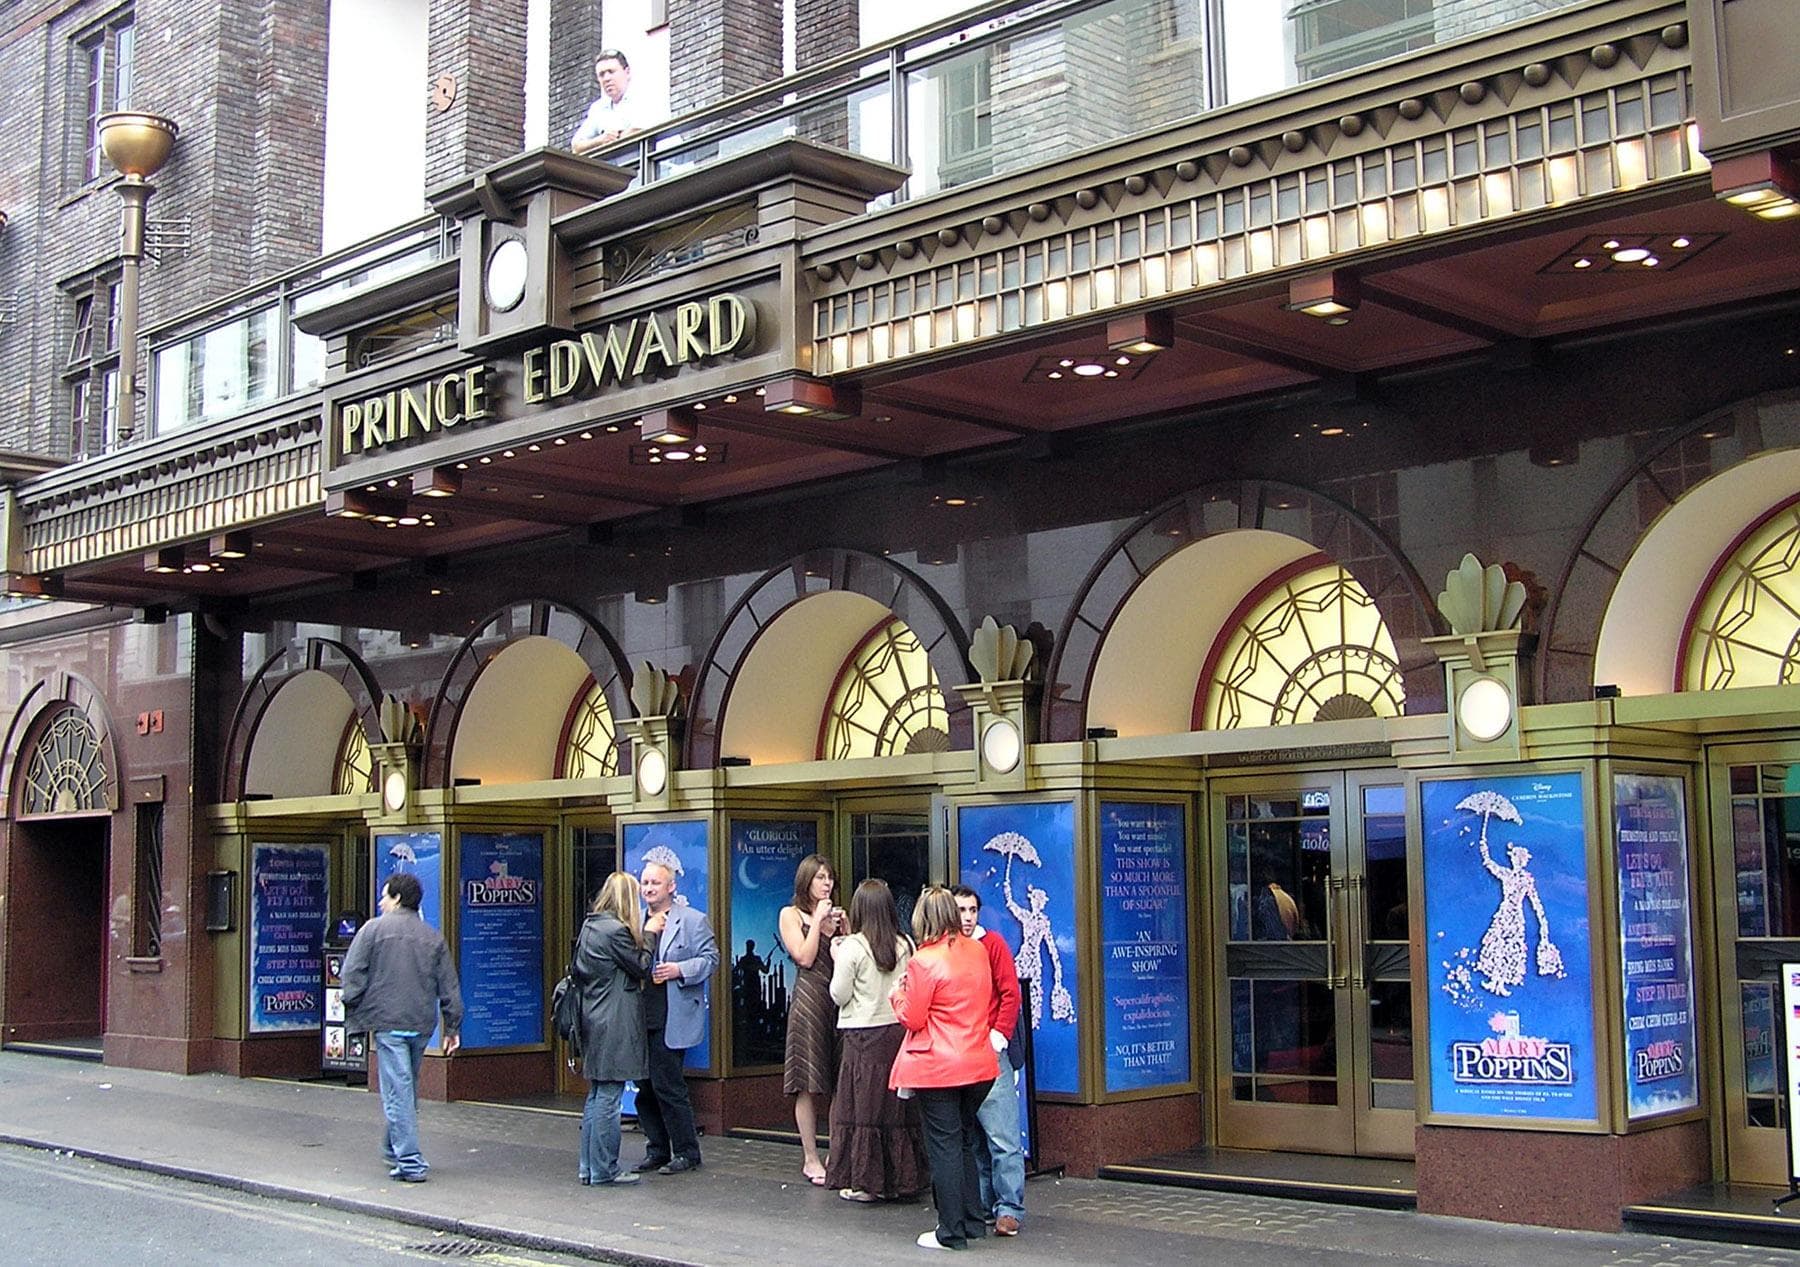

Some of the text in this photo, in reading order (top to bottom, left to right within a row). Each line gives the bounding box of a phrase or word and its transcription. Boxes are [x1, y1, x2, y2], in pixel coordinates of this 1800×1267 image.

[342, 292, 747, 455] PRINCE EDWARD
[1116, 857, 1136, 869] THIS
[1110, 872, 1123, 883] SO
[1124, 871, 1150, 883] MUCH
[471, 882, 534, 903] POPPINS
[1105, 886, 1129, 897] THAN
[1122, 899, 1135, 911] OF
[1112, 943, 1178, 959] AWE-INSPIRING
[266, 994, 315, 1012] POPPINS
[1147, 1040, 1175, 1053] BETTER
[1484, 1040, 1543, 1056] MARY
[1123, 1055, 1146, 1068] THAN
[1458, 1047, 1568, 1080] POPPINS
[1638, 1047, 1683, 1078] POPPINS
